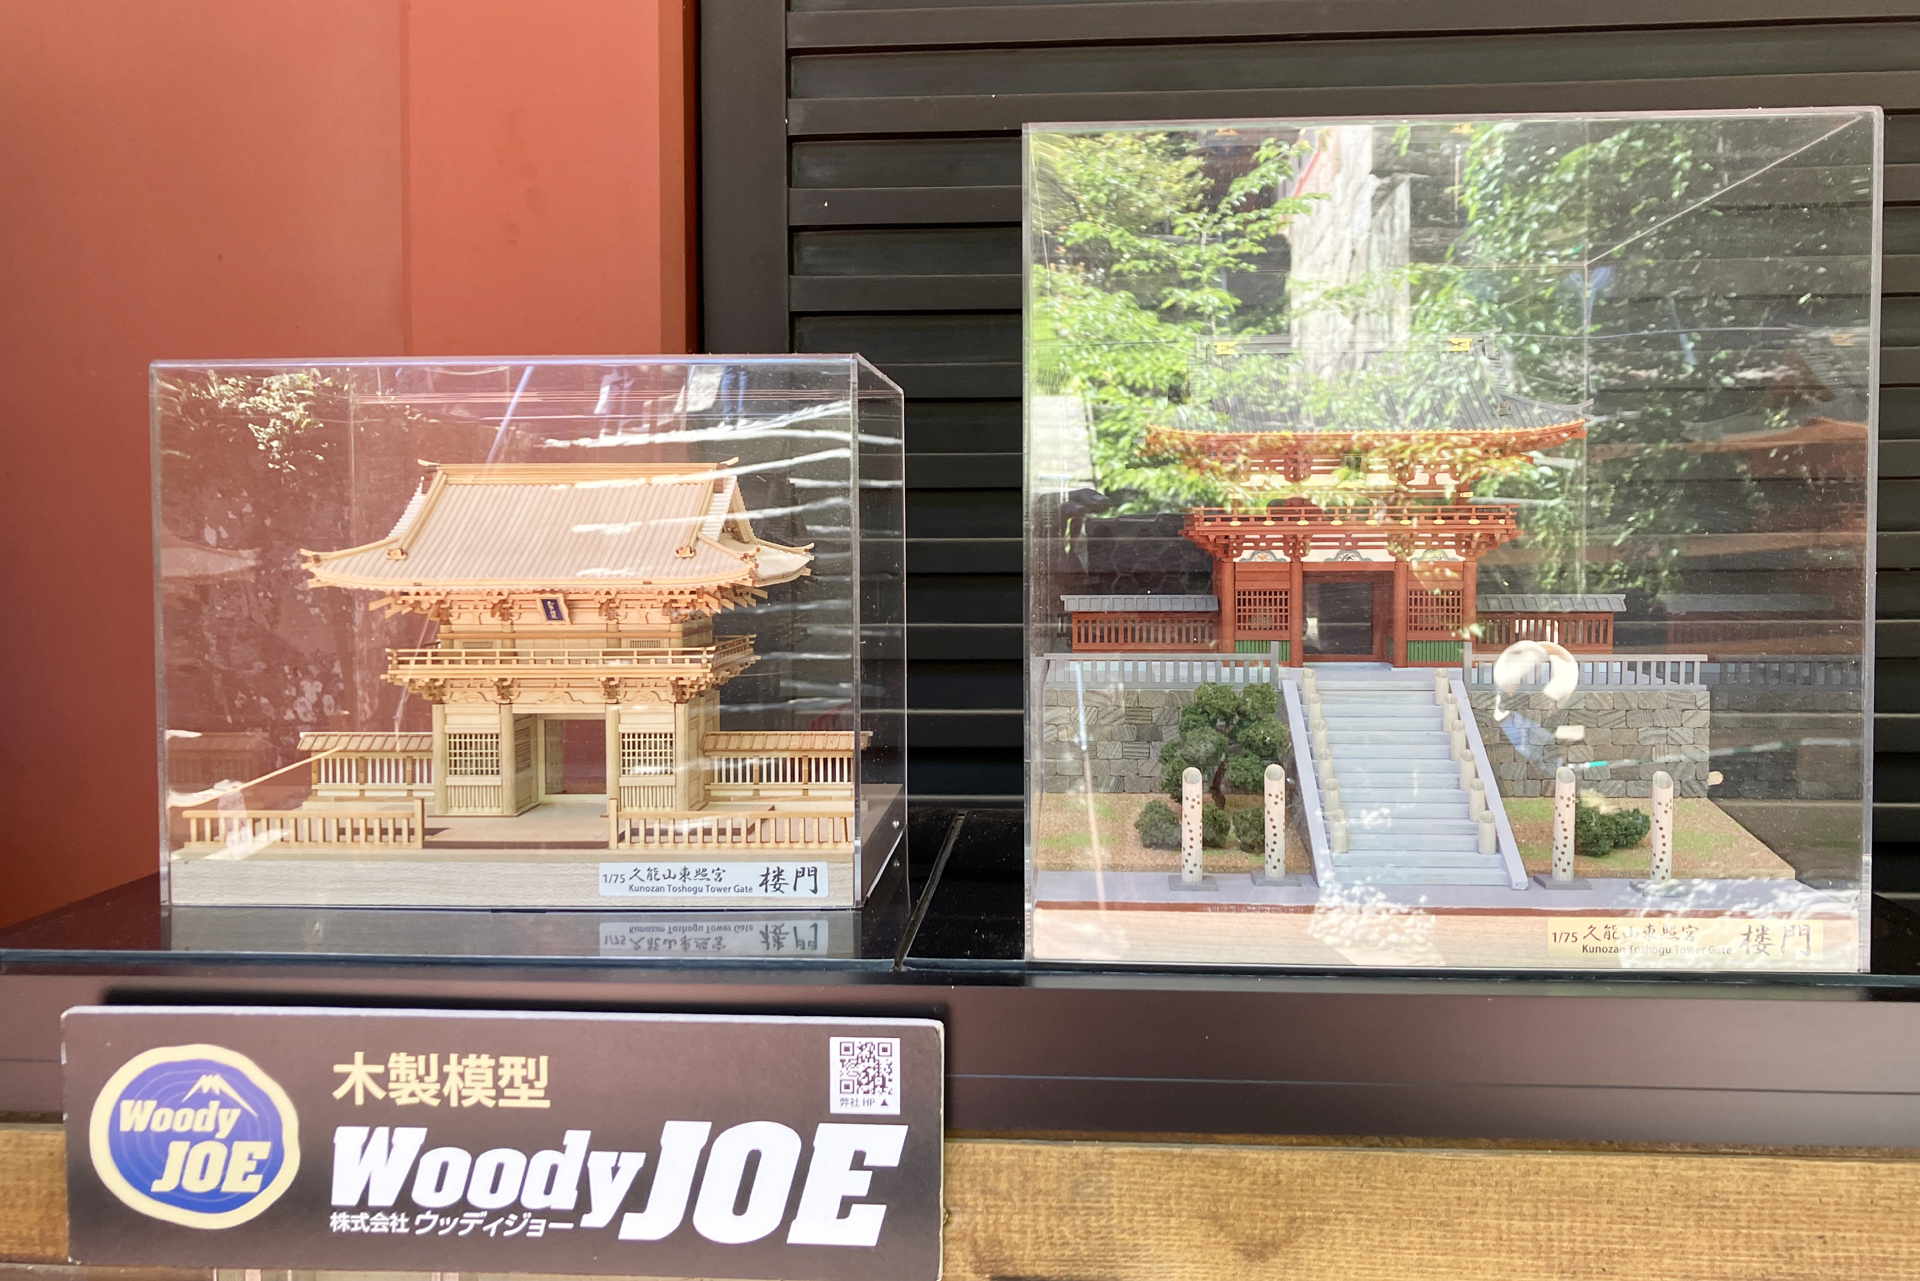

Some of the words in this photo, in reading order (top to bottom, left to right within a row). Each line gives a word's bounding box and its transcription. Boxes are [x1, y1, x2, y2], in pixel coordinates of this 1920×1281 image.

[602, 873, 626, 884] 1/75
[629, 866, 726, 882] 久能山東照宮
[758, 866, 818, 894] 楼門
[628, 884, 665, 893] Kunozan
[667, 884, 703, 894] Toshogu
[705, 884, 731, 893] Tower
[733, 884, 753, 893] Gate
[1552, 932, 1578, 943] 1/75
[1582, 924, 1699, 942] 久能山東照宮
[1739, 924, 1811, 956] 楼門
[1582, 944, 1626, 954] Kunozan
[1629, 944, 1672, 956] Toshogu
[1674, 945, 1706, 954] Tower
[1708, 945, 1732, 955] Gate
[332, 1051, 551, 1108] 木製模型
[840, 1097, 860, 1107] 弊社
[863, 1098, 875, 1106] HP
[119, 1099, 241, 1138] Woody
[151, 1140, 273, 1193] JOE
[330, 1211, 410, 1234] 株式会社
[414, 1210, 575, 1237] ウッディジョー
